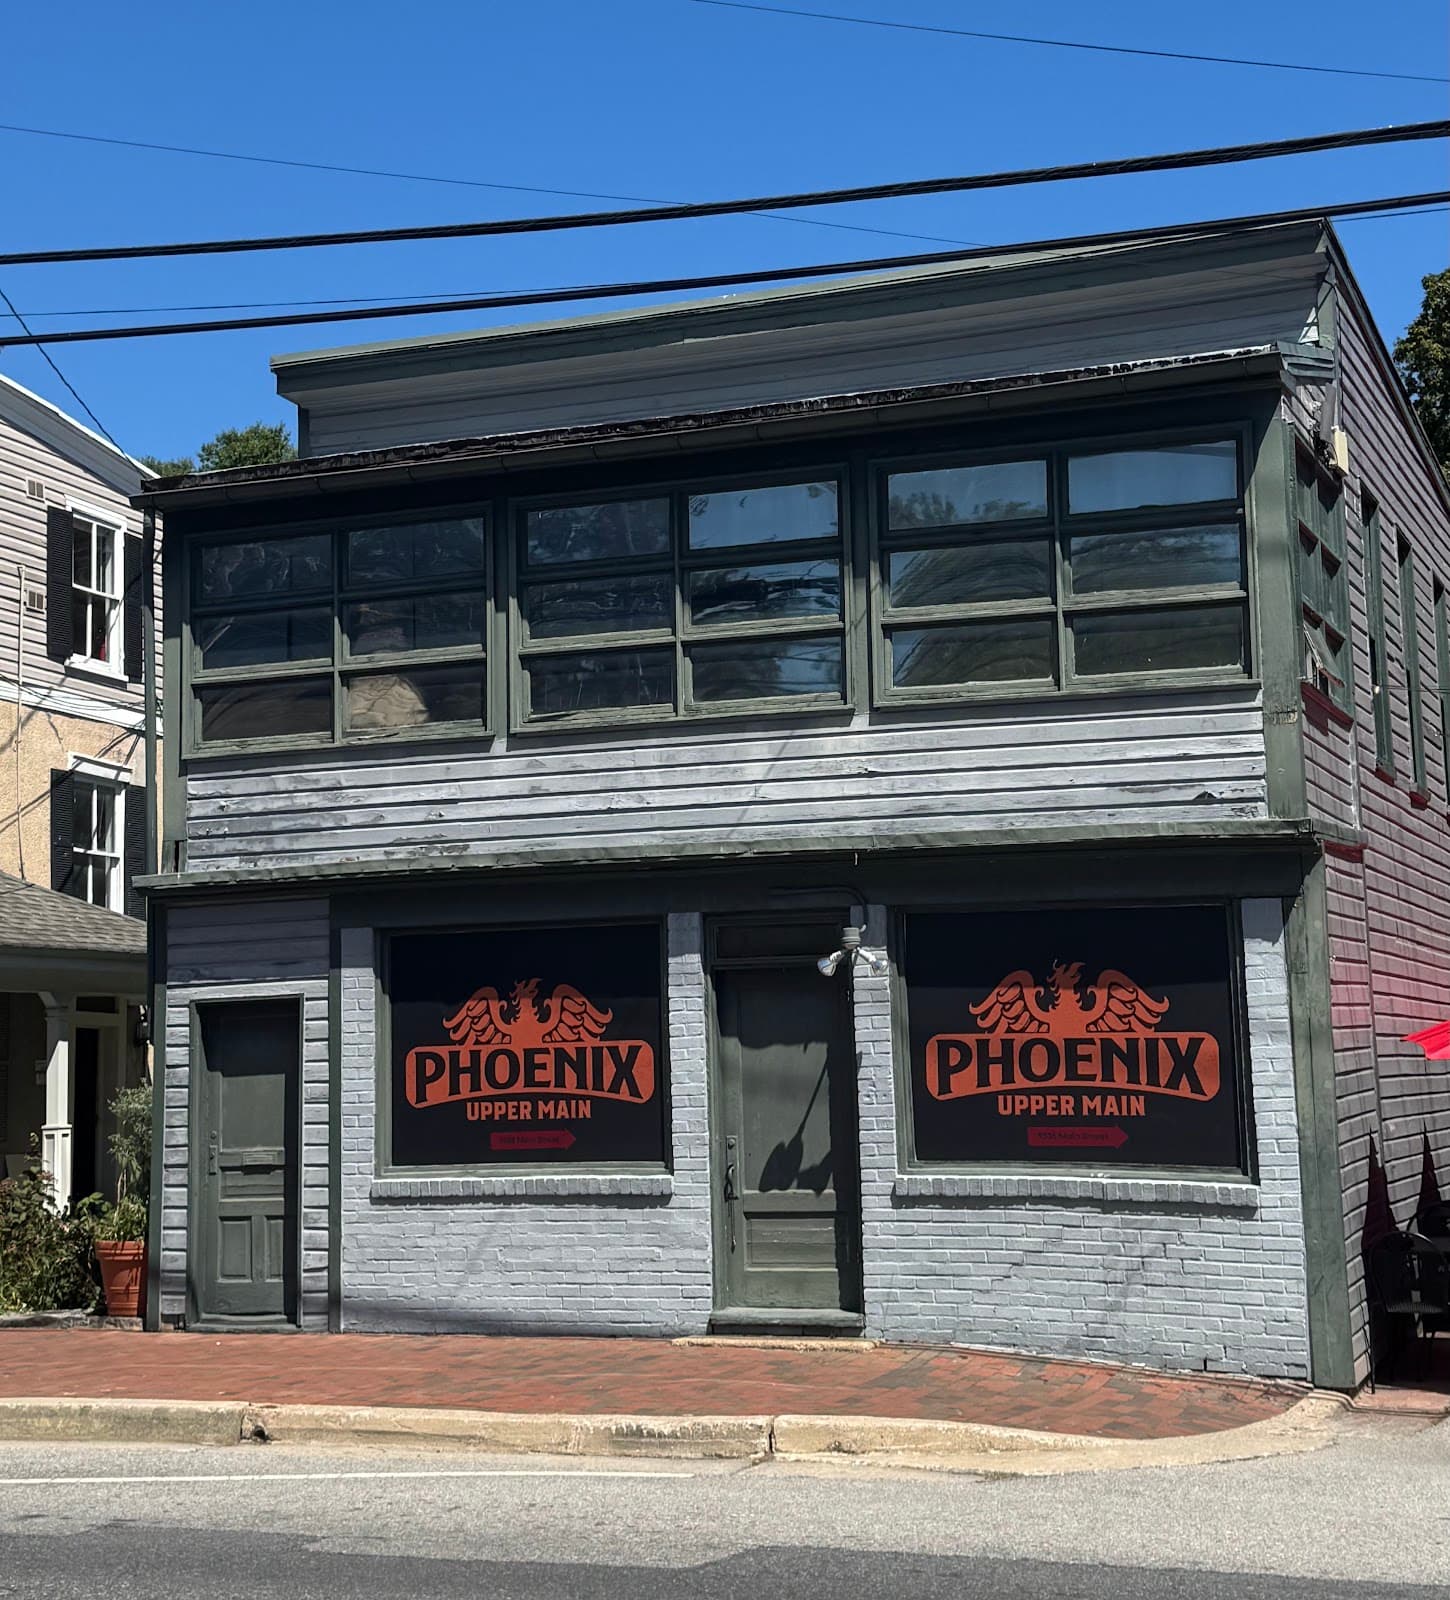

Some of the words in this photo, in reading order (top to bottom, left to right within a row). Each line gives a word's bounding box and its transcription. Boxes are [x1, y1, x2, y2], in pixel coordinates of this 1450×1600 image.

[415, 1045, 644, 1104] PHOENIX
[936, 1037, 1208, 1097] PHOENIX
[466, 1101, 532, 1121] UPPER
[538, 1099, 592, 1120] MAIN
[998, 1095, 1075, 1116] UPPER
[1082, 1095, 1145, 1117] MAIN
